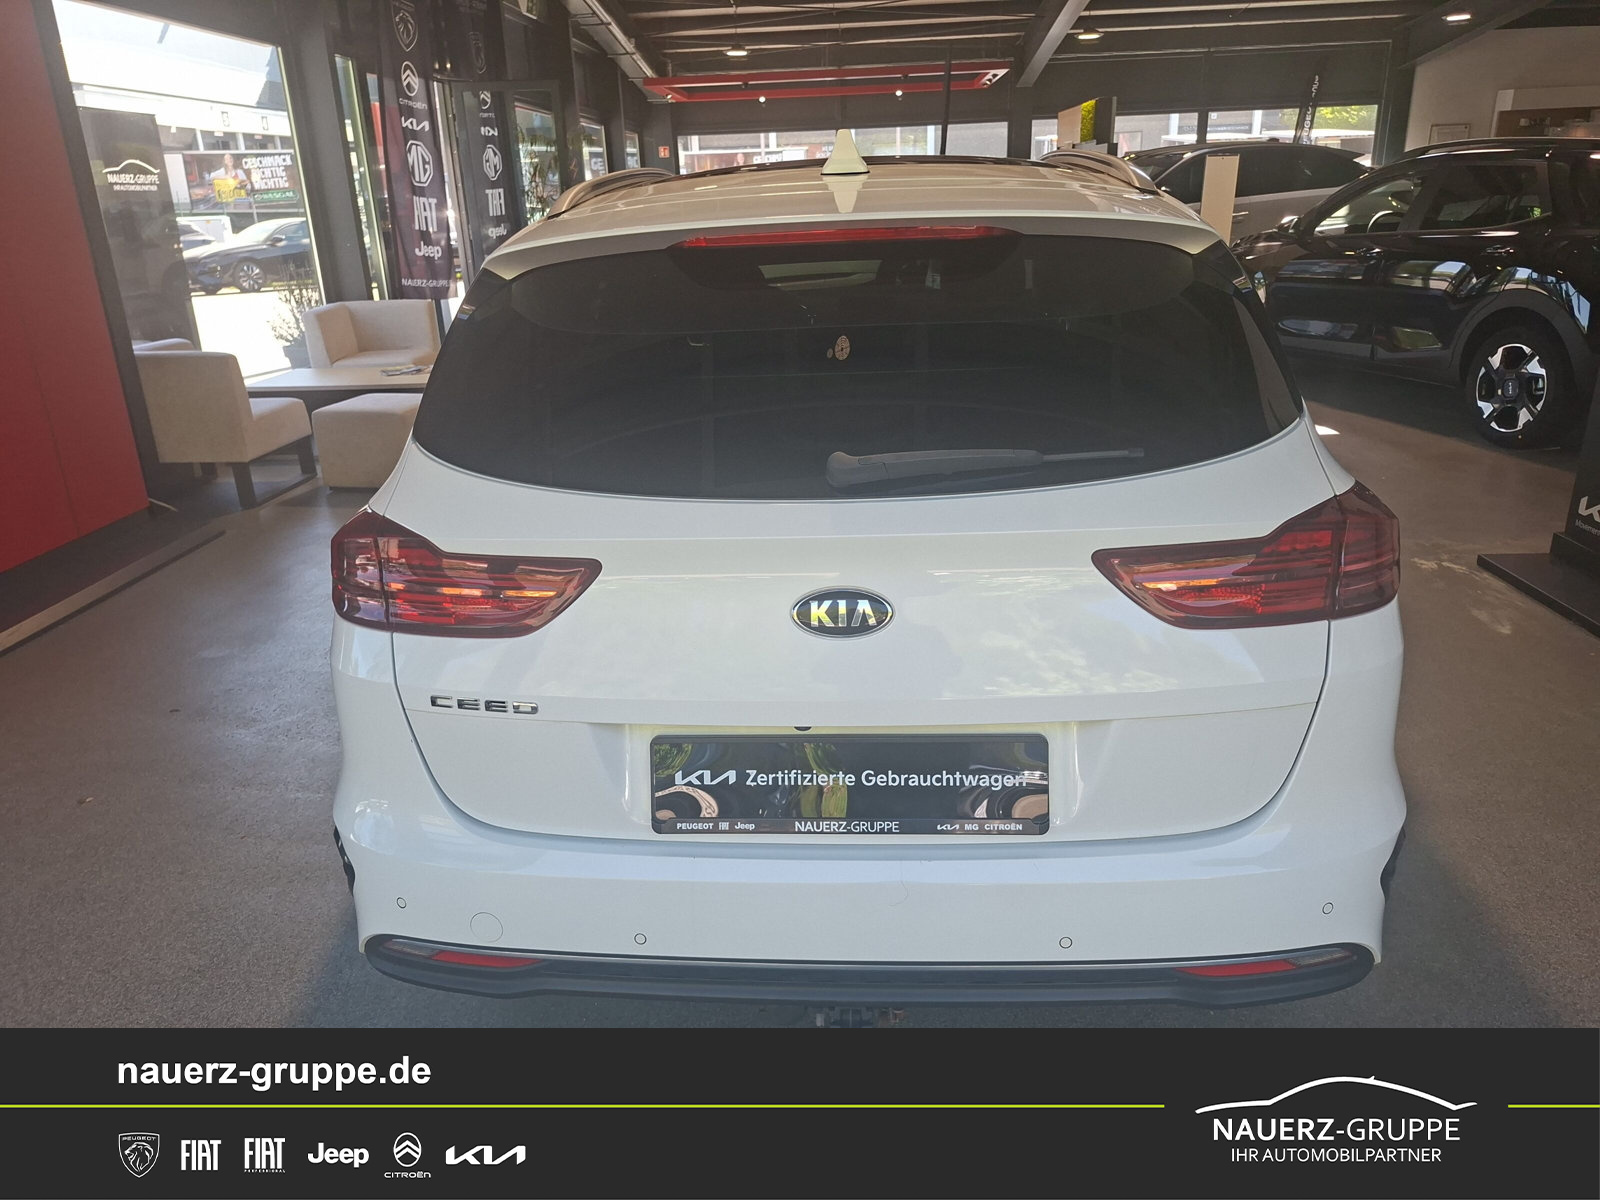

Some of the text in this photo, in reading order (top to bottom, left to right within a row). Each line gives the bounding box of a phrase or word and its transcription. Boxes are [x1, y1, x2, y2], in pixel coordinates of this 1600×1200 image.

[407, 143, 432, 184] MG
[413, 195, 438, 232] FIAT
[415, 241, 442, 260] Jeep
[809, 600, 877, 627] KIA
[430, 694, 539, 715] CEED
[675, 769, 1027, 790] KIA Zertifizierte Gebrauchtwagen
[676, 822, 714, 830] PEUGEOT
[734, 821, 756, 831] Jeep
[794, 820, 900, 833] NAUERZ-GRUPPE
[964, 823, 979, 831] MG
[984, 822, 1023, 831] CITROËN
